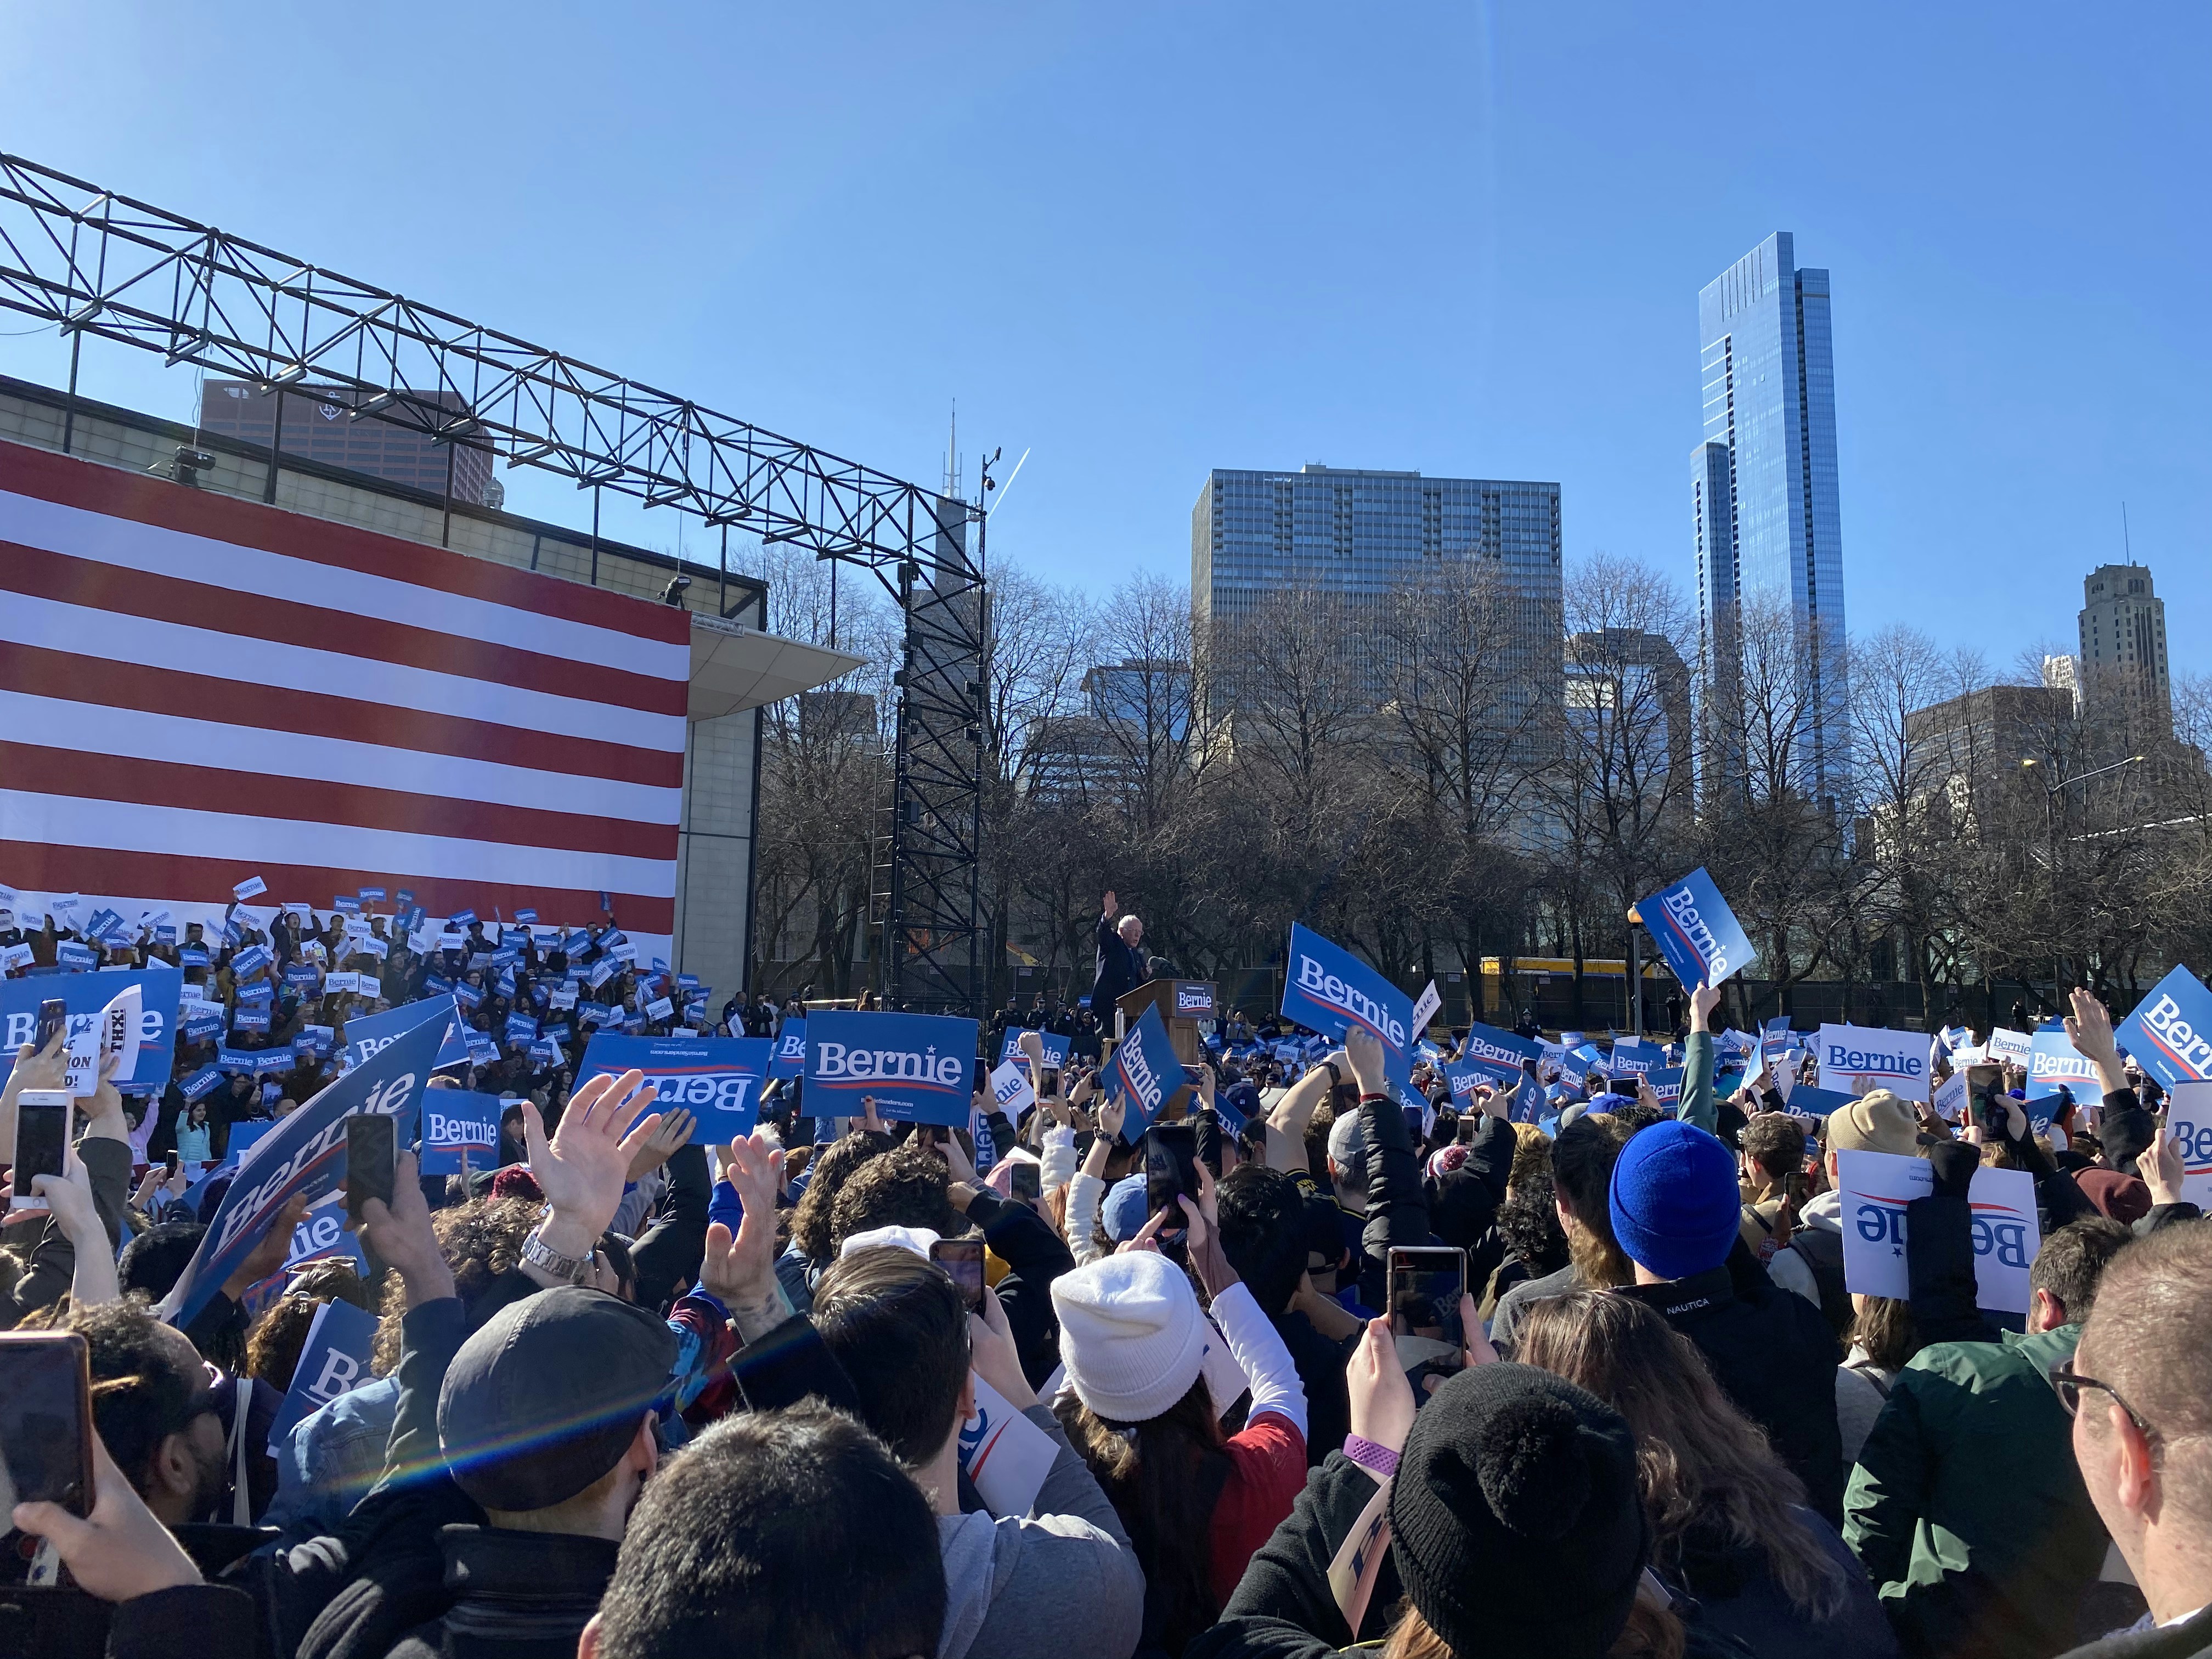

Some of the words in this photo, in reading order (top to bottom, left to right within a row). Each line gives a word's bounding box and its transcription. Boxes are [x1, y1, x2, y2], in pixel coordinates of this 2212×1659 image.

[91, 915, 117, 938] Bernie
[347, 923, 370, 933] Bernie
[1666, 887, 1727, 977] Bernie
[492, 950, 515, 960] Bernie
[566, 940, 587, 955] Bernie
[613, 947, 635, 958] Bernie
[235, 953, 262, 973] Bernie
[329, 978, 357, 986] Bernie
[594, 967, 607, 982] ernie
[240, 986, 270, 998] Bernie
[362, 981, 379, 991] Bernie
[456, 986, 479, 1001] Bernie
[1179, 992, 1211, 1008] Bernie
[1298, 954, 1405, 1048] Bernie
[649, 1003, 670, 1015] Bernie
[236, 1014, 268, 1024] Bernie
[509, 1017, 534, 1030] Bernie
[3, 1010, 163, 1049] Bre
[111, 1009, 125, 1052] THX!
[187, 1023, 219, 1036] Bernie
[1764, 1028, 1786, 1041] Bernie
[531, 1045, 552, 1056] Bernie
[1722, 1034, 1741, 1051] Bern
[1994, 1037, 2030, 1054] Bernie
[1005, 1040, 1062, 1064] Beie
[1277, 1049, 1296, 1058] Bernie
[1421, 1045, 1437, 1059] Bernie
[1470, 1036, 1523, 1066] Berni
[220, 1054, 253, 1066] Bernie
[257, 1054, 291, 1065] Bernie
[816, 1042, 962, 1086] Bernie
[1595, 1058, 1610, 1069] Ber
[1617, 1056, 1653, 1071] Bern
[1828, 1045, 1922, 1075] Bernie
[1955, 1056, 1978, 1068] Bernie
[2032, 1052, 2099, 1077] Berni
[1122, 1028, 1162, 1111] Bernie
[1561, 1063, 1583, 1088] Bernie
[183, 1071, 217, 1096] Bernie
[996, 1077, 1022, 1104] nie
[625, 1076, 752, 1113] Bern
[861, 1098, 913, 1107] BieSanders.com
[1937, 1085, 1963, 1111] Bernie
[1521, 1087, 1536, 1123] nie
[429, 1114, 496, 1146] Bernie
[975, 1113, 992, 1169] Ber
[218, 1073, 415, 1246] Bernie
[1857, 1204, 2029, 1268] Beie
[1667, 1298, 1709, 1314] NAUTICA
